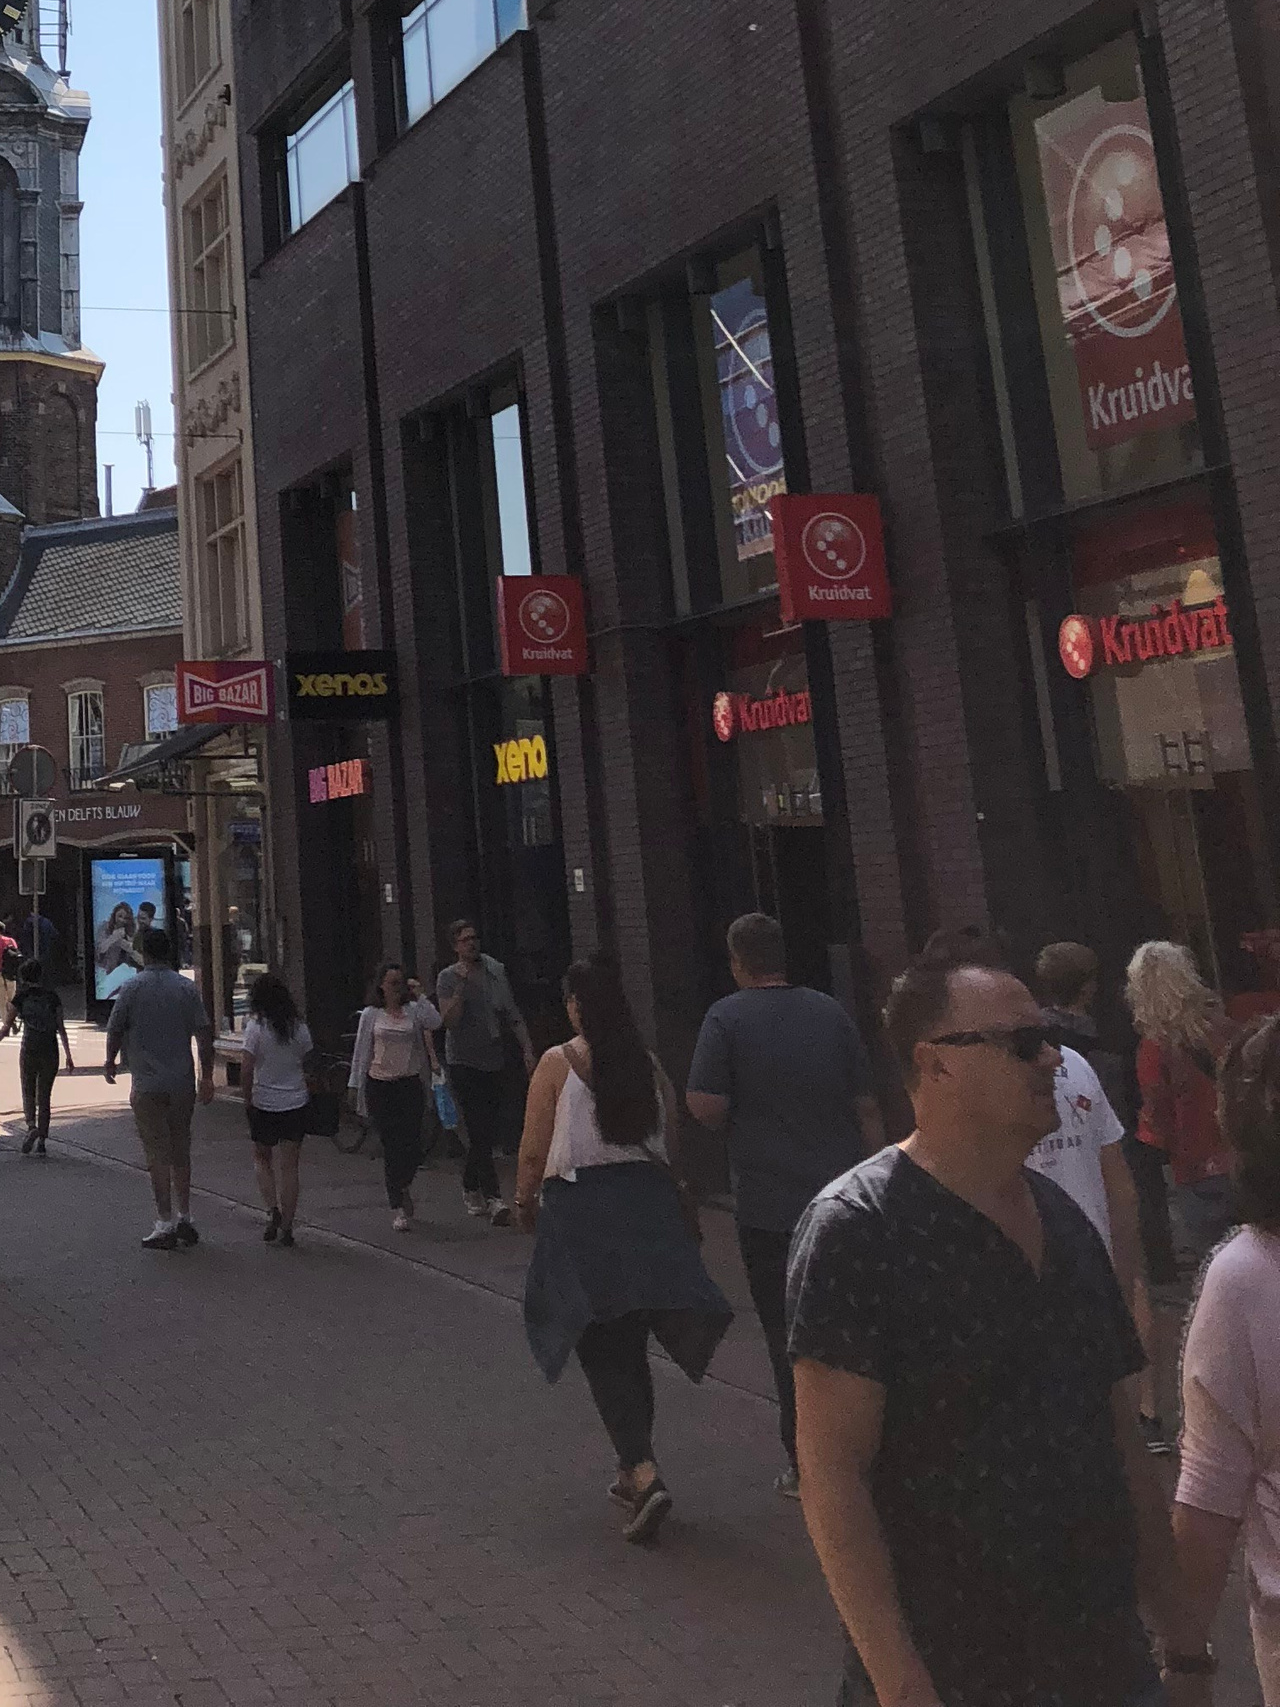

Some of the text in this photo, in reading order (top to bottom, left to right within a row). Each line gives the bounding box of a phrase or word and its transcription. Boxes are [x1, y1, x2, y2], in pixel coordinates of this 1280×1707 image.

[808, 585, 873, 602] Kruidvat
[522, 647, 573, 661] Kruidvat
[193, 679, 260, 706] BIG BAZAR
[294, 672, 389, 698] xenos
[308, 758, 364, 804] BIG BAZAR
[69, 806, 104, 822] DELFTS
[105, 804, 142, 820] BLAUW
